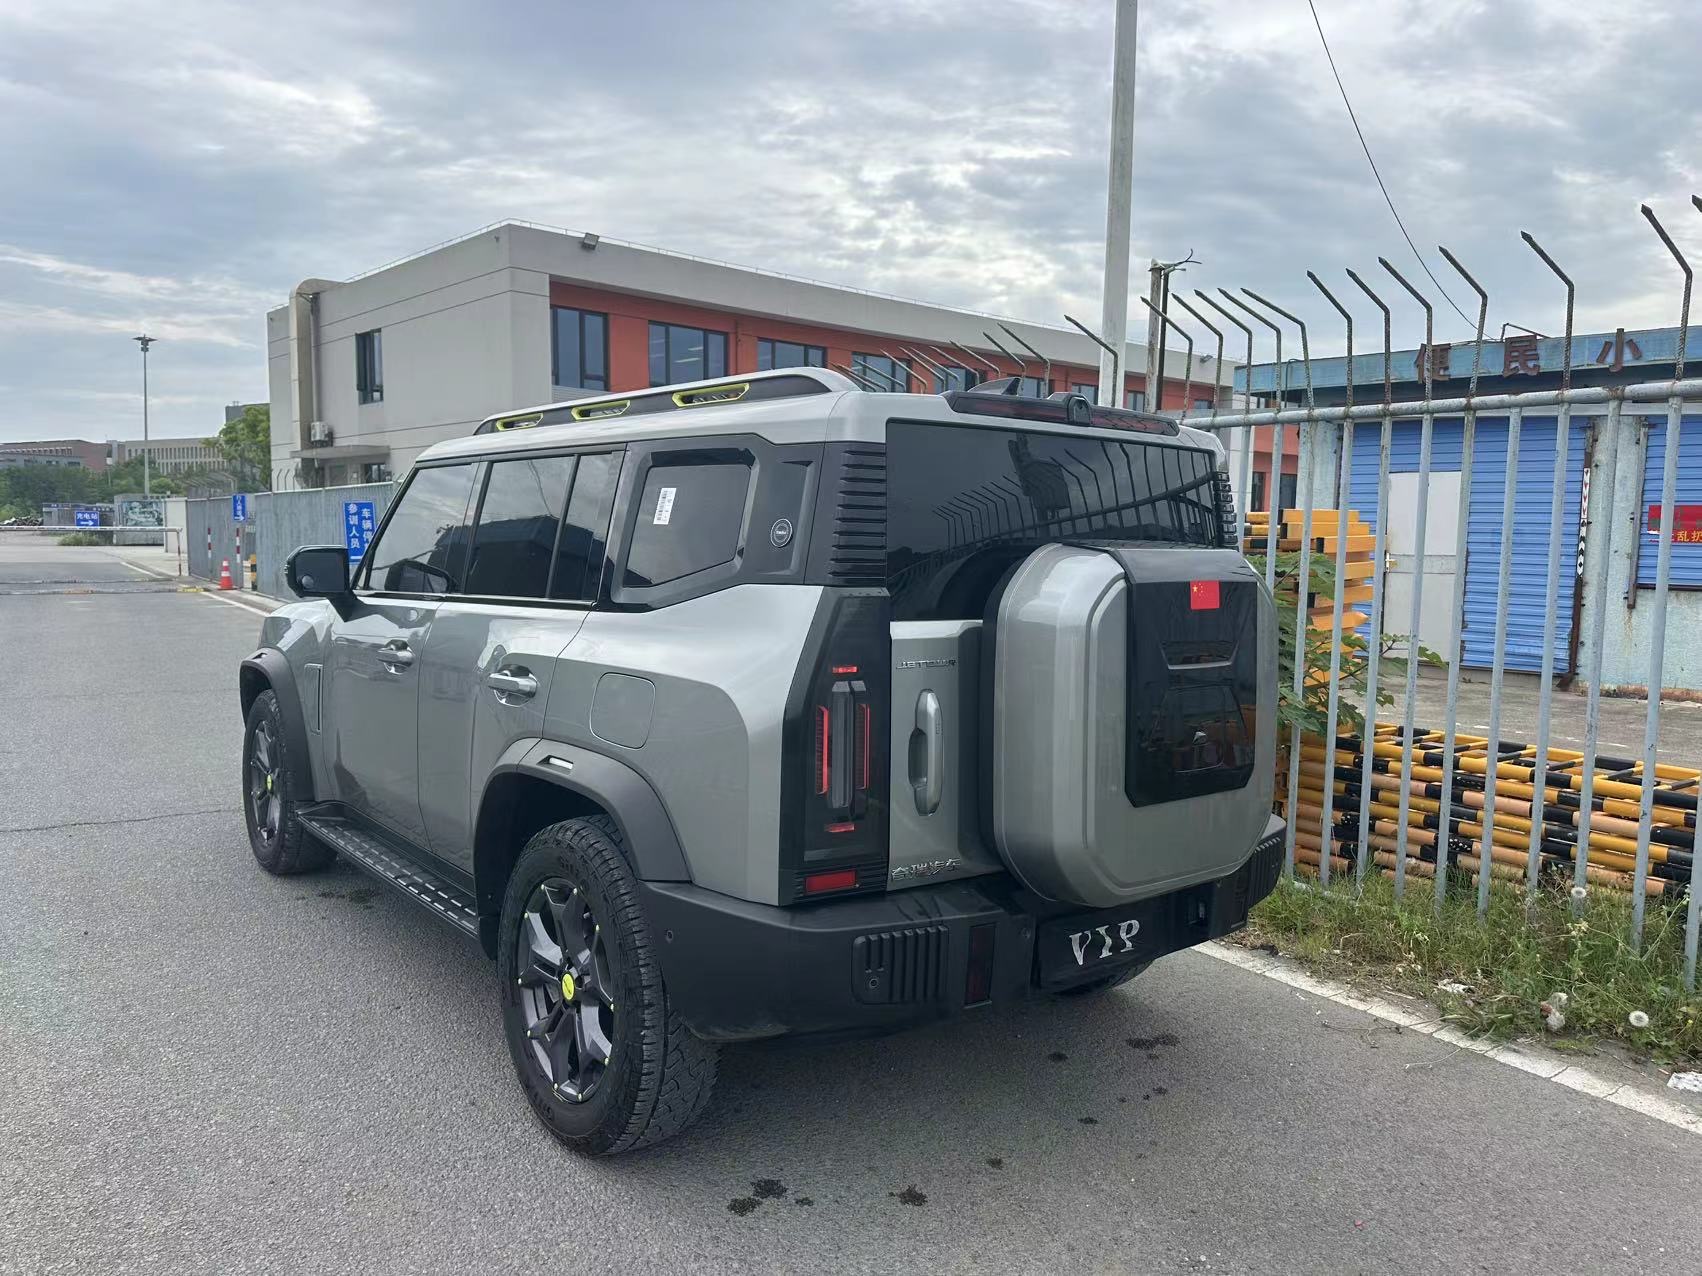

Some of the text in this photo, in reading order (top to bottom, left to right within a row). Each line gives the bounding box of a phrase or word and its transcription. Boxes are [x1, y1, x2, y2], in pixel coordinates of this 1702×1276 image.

[1414, 328, 1643, 384] 便民小
[77, 512, 98, 520] 充电站
[347, 503, 360, 549] 参训人员
[1672, 530, 1702, 542] 乱扔
[1069, 919, 1140, 966] VIP
